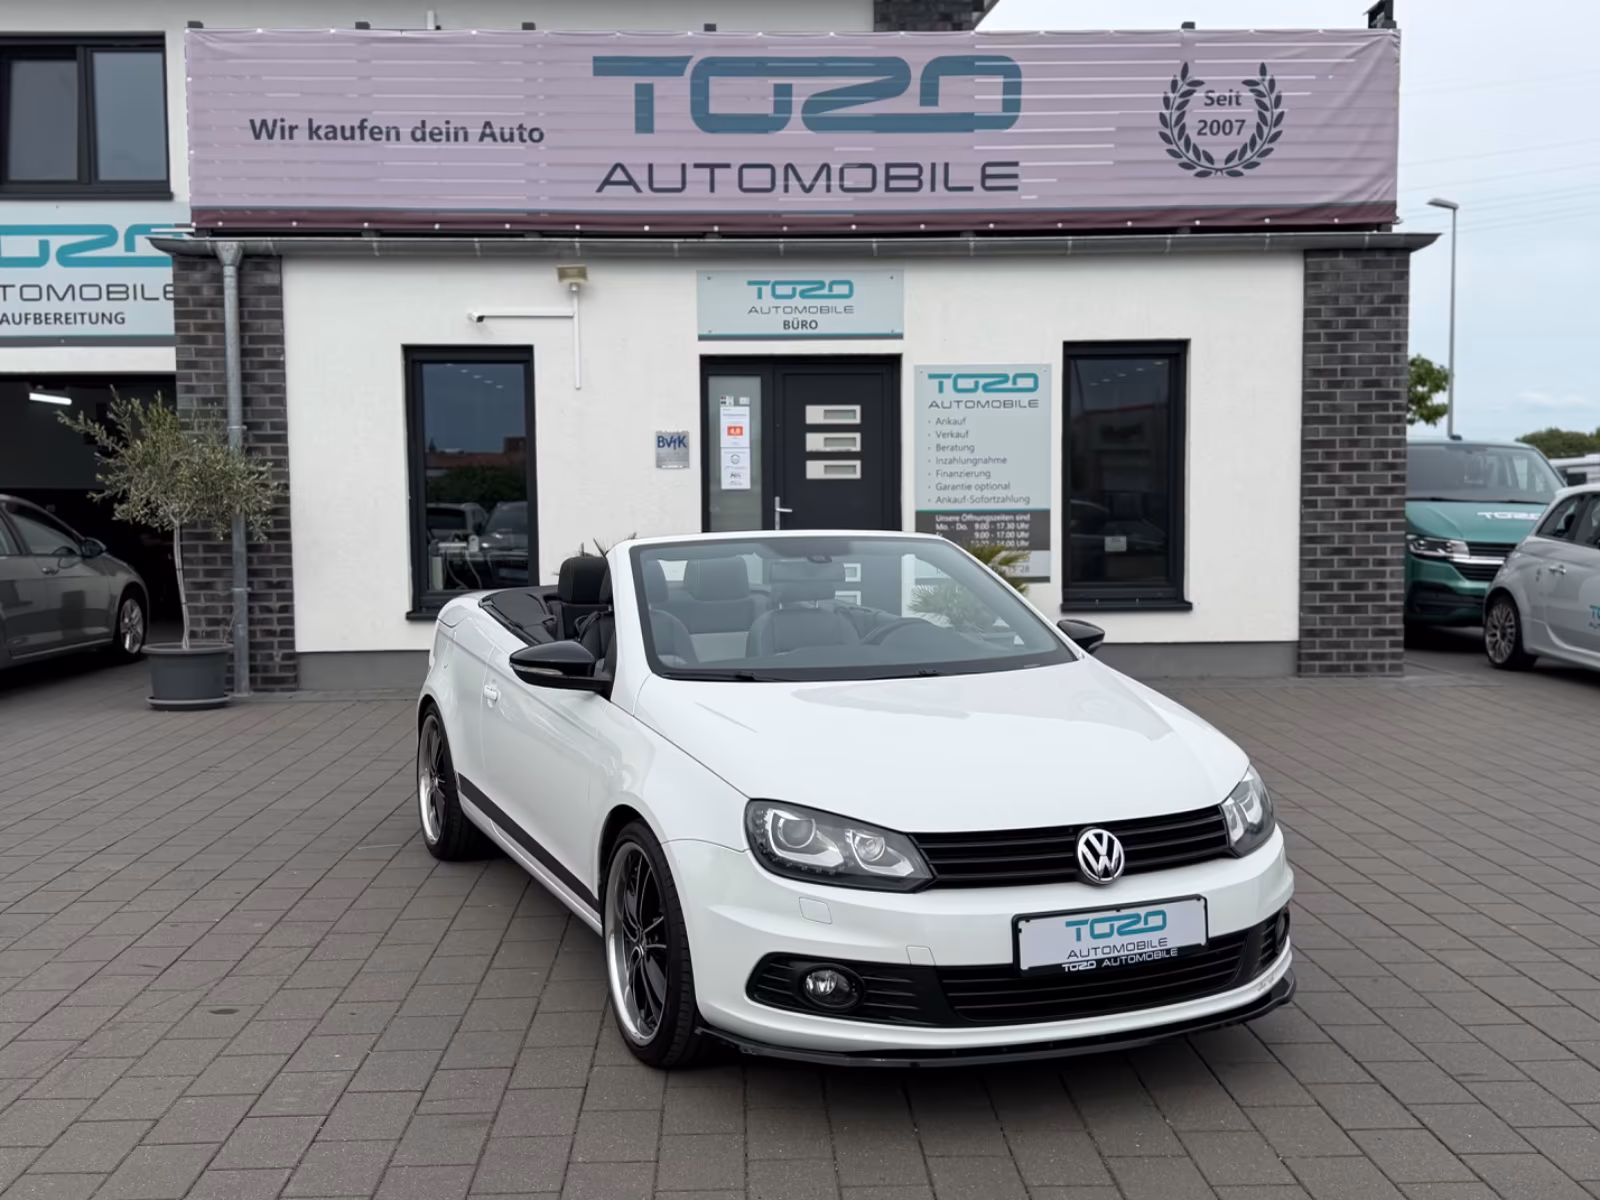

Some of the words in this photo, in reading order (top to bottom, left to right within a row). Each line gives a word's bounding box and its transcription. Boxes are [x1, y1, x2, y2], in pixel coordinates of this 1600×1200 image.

[1204, 89, 1242, 107] Seit
[249, 118, 298, 141] Wir
[307, 118, 401, 142] kaufen
[410, 120, 469, 143] dein
[478, 121, 545, 144] Auto
[1197, 119, 1247, 136] 2007
[595, 161, 1019, 194] AUTOMOBILE
[747, 305, 854, 315] AUTOMOBILE
[0, 312, 126, 326] AUFBEREITUNG
[783, 317, 818, 330] BÜRO
[928, 399, 1040, 409] AUTOMOBILE
[936, 417, 966, 425] Ankauf
[936, 430, 969, 439] Verkauf
[936, 443, 975, 454] Beratung
[936, 456, 1007, 467] Inzahlungnahme
[936, 469, 991, 479] Finanzierung
[936, 482, 972, 491] Garantie
[975, 482, 1011, 492] optional
[936, 495, 1031, 505] Ankauf-Sofortzahlung
[1067, 937, 1167, 960] AUTOMOBILE
[1102, 948, 1178, 967] AUTOMOBILE
